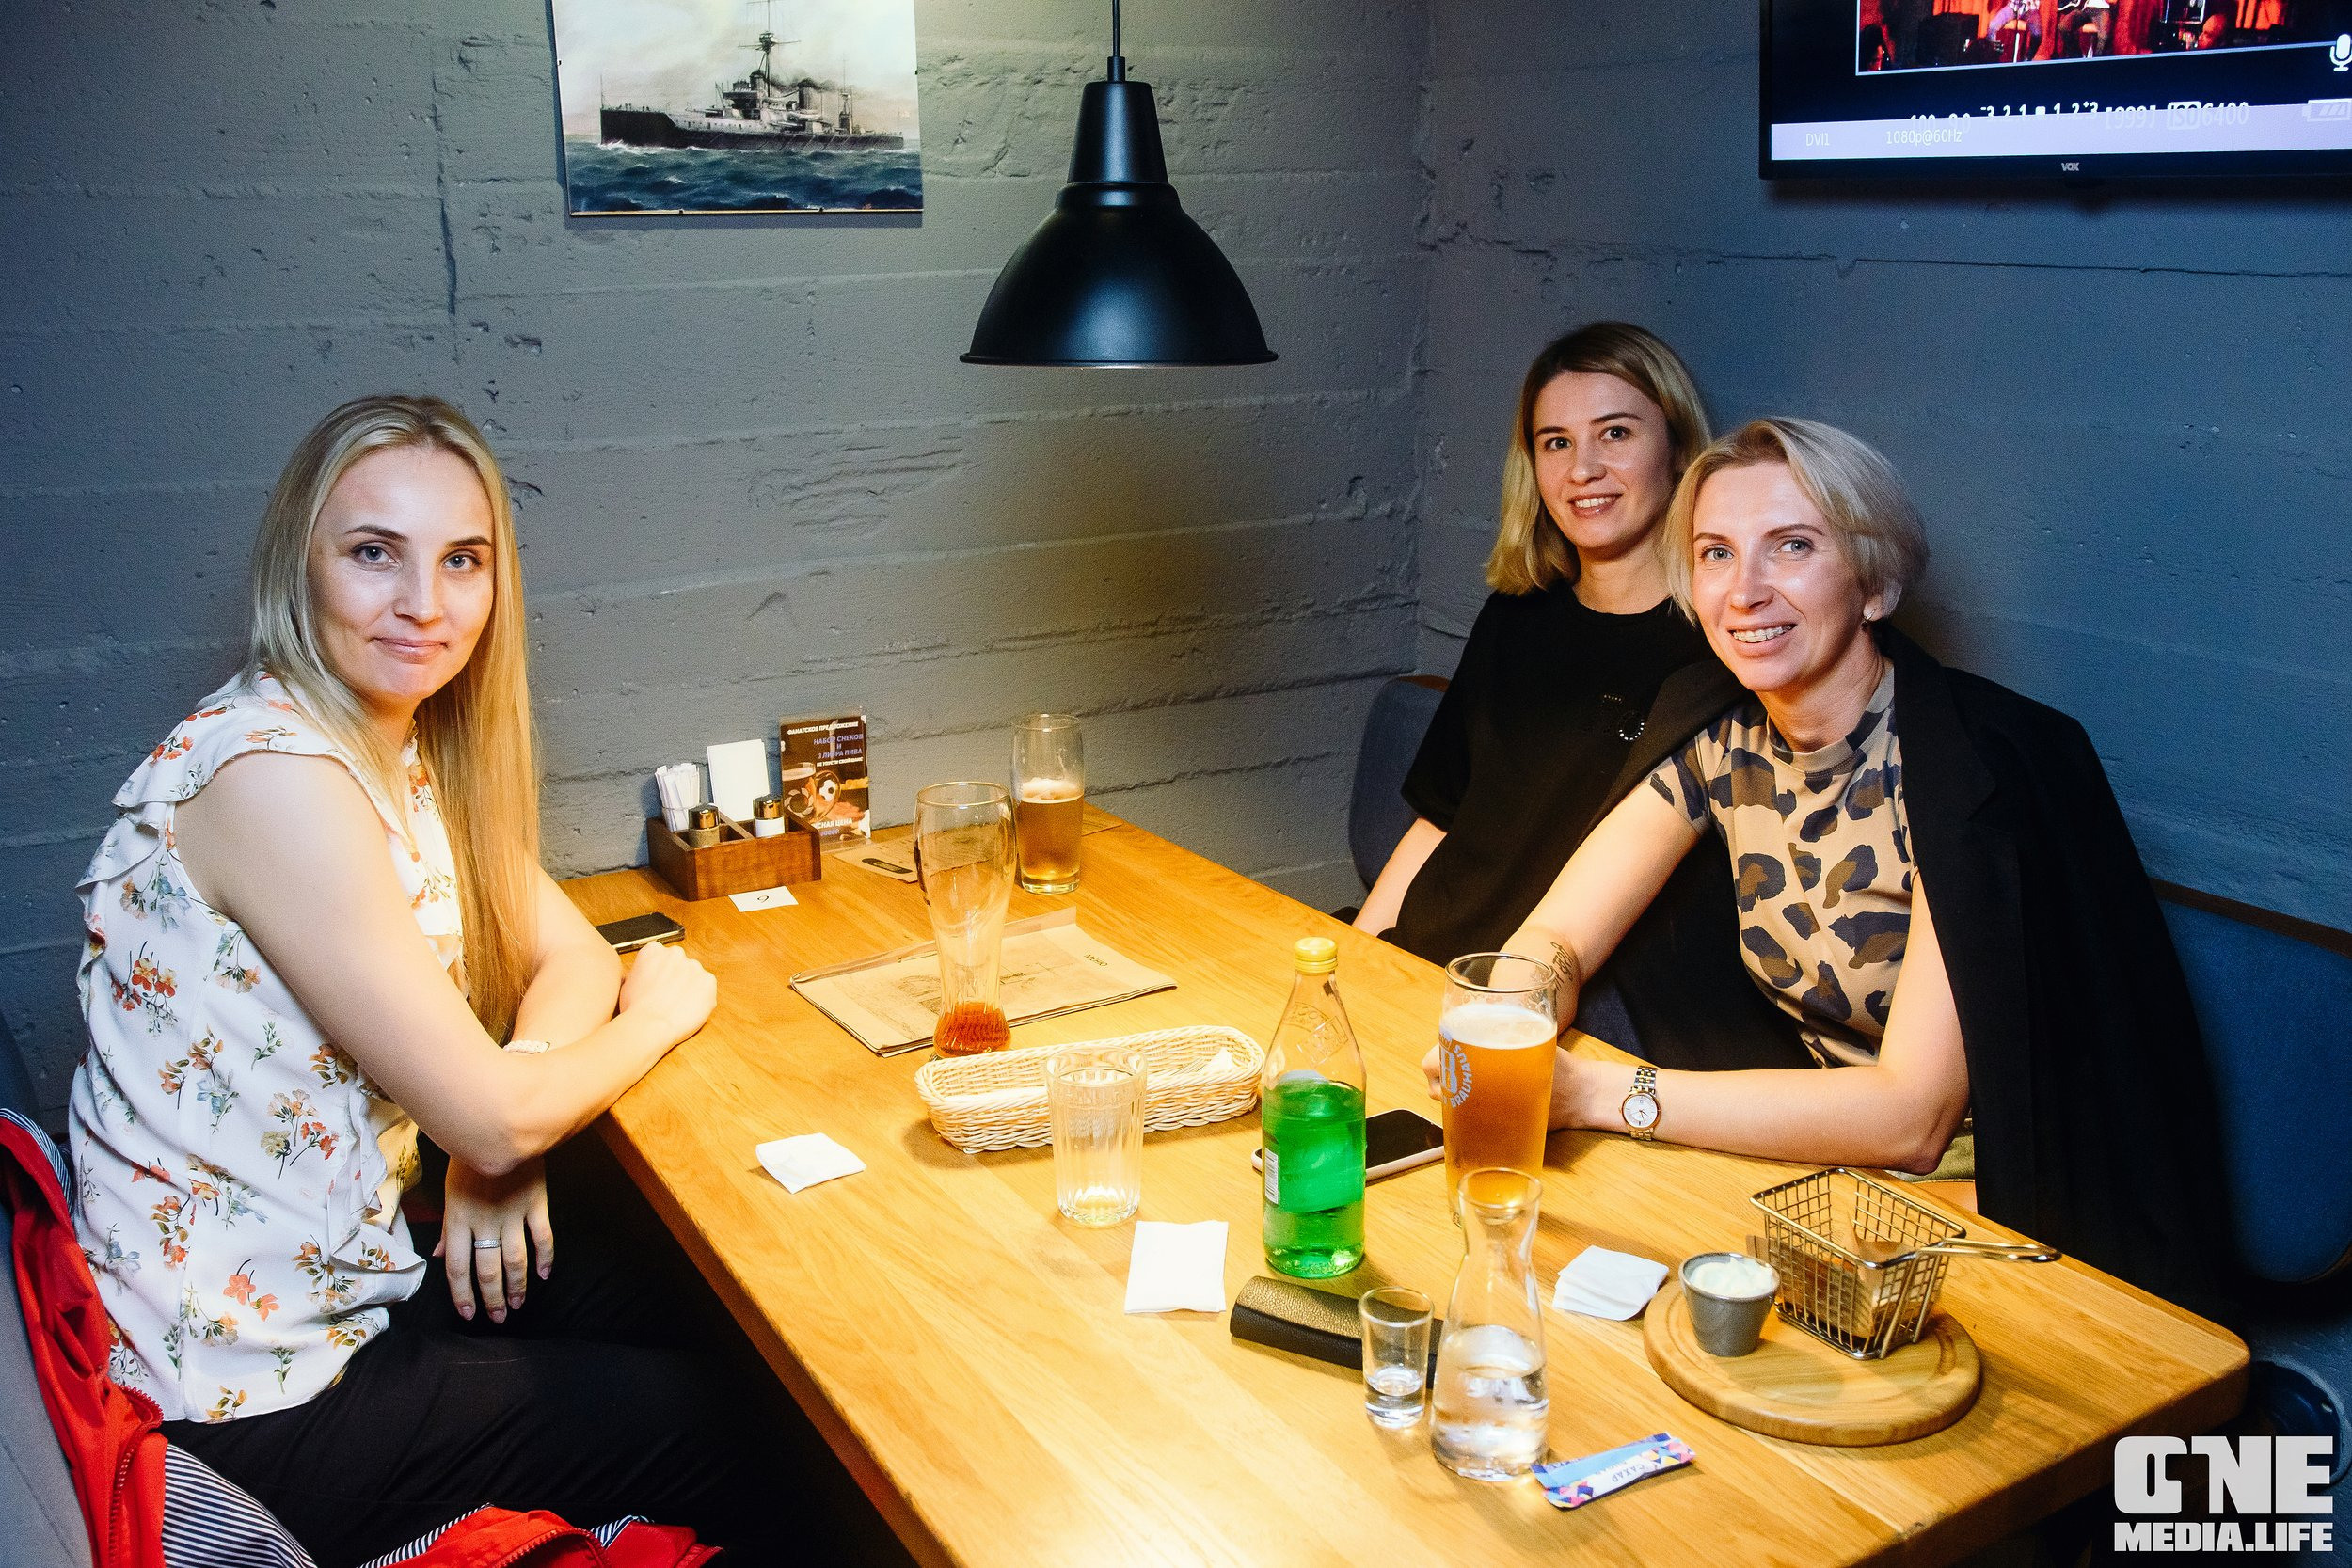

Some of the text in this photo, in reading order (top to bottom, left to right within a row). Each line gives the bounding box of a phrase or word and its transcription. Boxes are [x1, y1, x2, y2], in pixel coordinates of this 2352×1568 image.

[1885, 129, 1963, 147] 1080p@60Hz
[2060, 162, 2080, 172] VOX
[813, 734, 864, 745] НАБОР СНЕКОВ
[821, 750, 844, 758] ЛИТРА
[844, 748, 863, 756] ПИВА
[834, 817, 853, 827] ЦЕНА
[1611, 1464, 1645, 1483] САХАР
